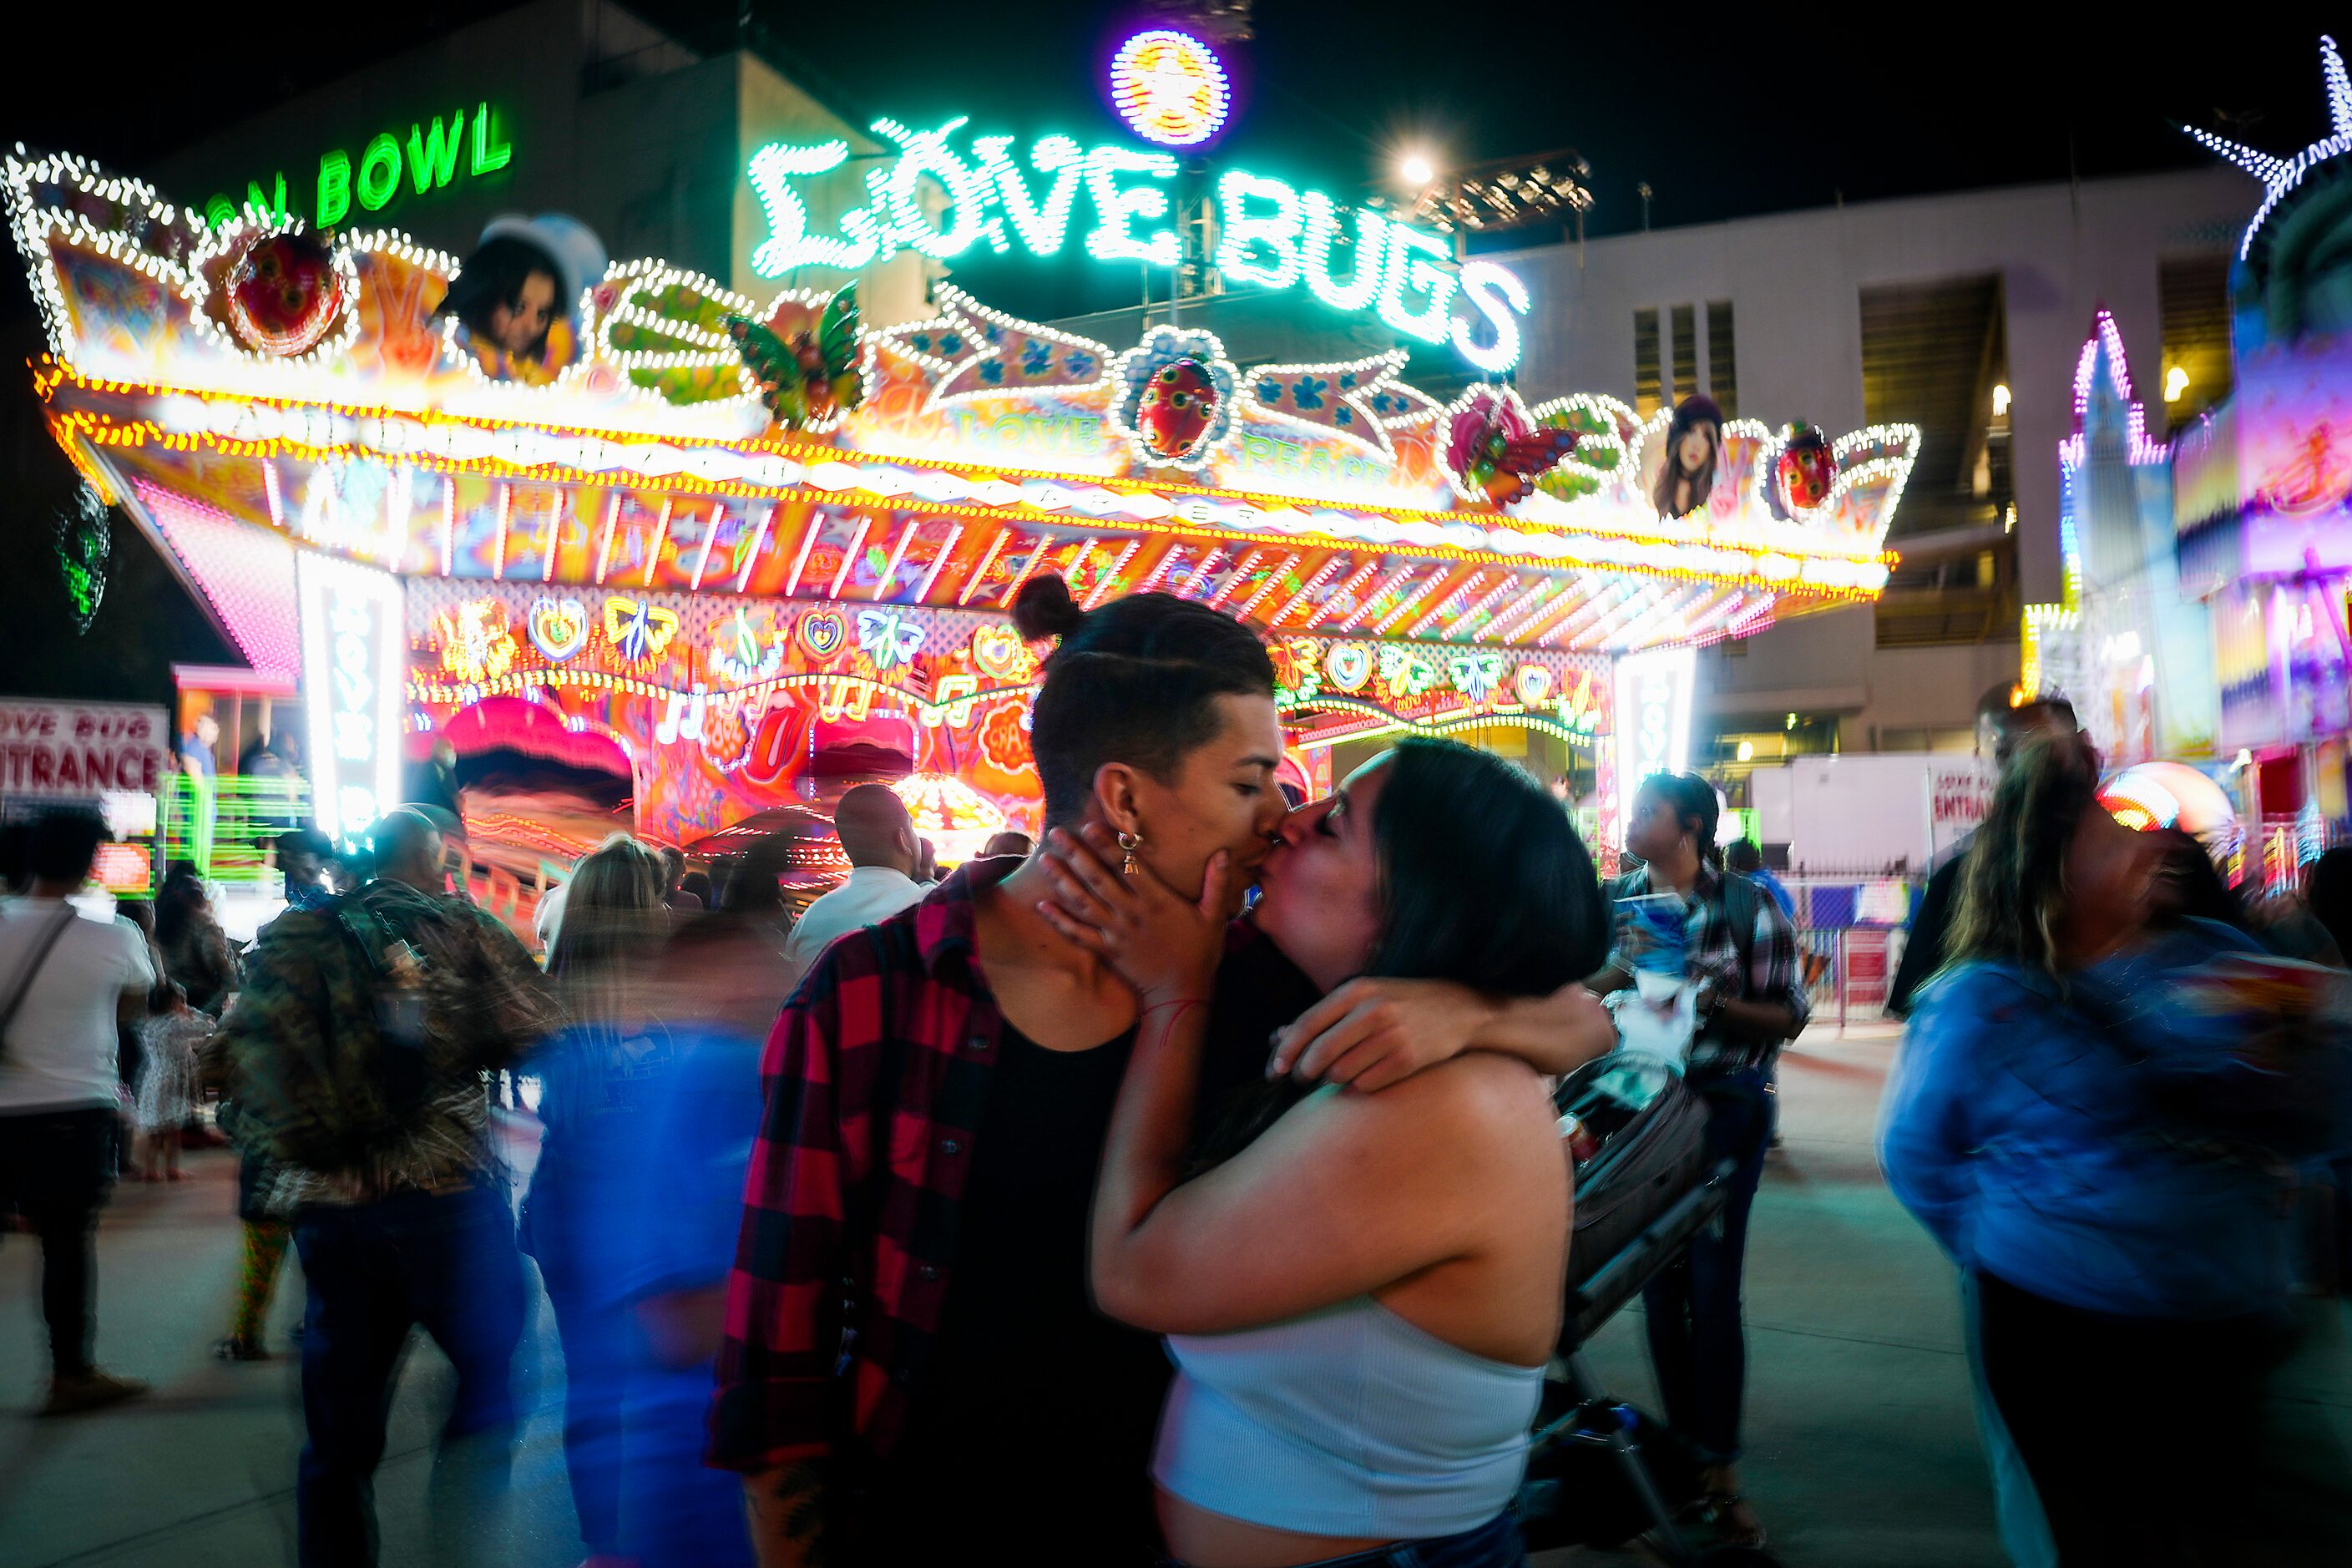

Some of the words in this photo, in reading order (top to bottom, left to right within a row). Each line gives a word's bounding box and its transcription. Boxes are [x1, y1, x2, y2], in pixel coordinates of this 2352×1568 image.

[316, 101, 512, 230] BOWL
[748, 114, 1182, 280] LOVE
[1216, 167, 1531, 374] BUGS
[953, 412, 1103, 454] LOVE
[1239, 431, 1390, 486] PEACE
[73, 710, 152, 740] BUG
